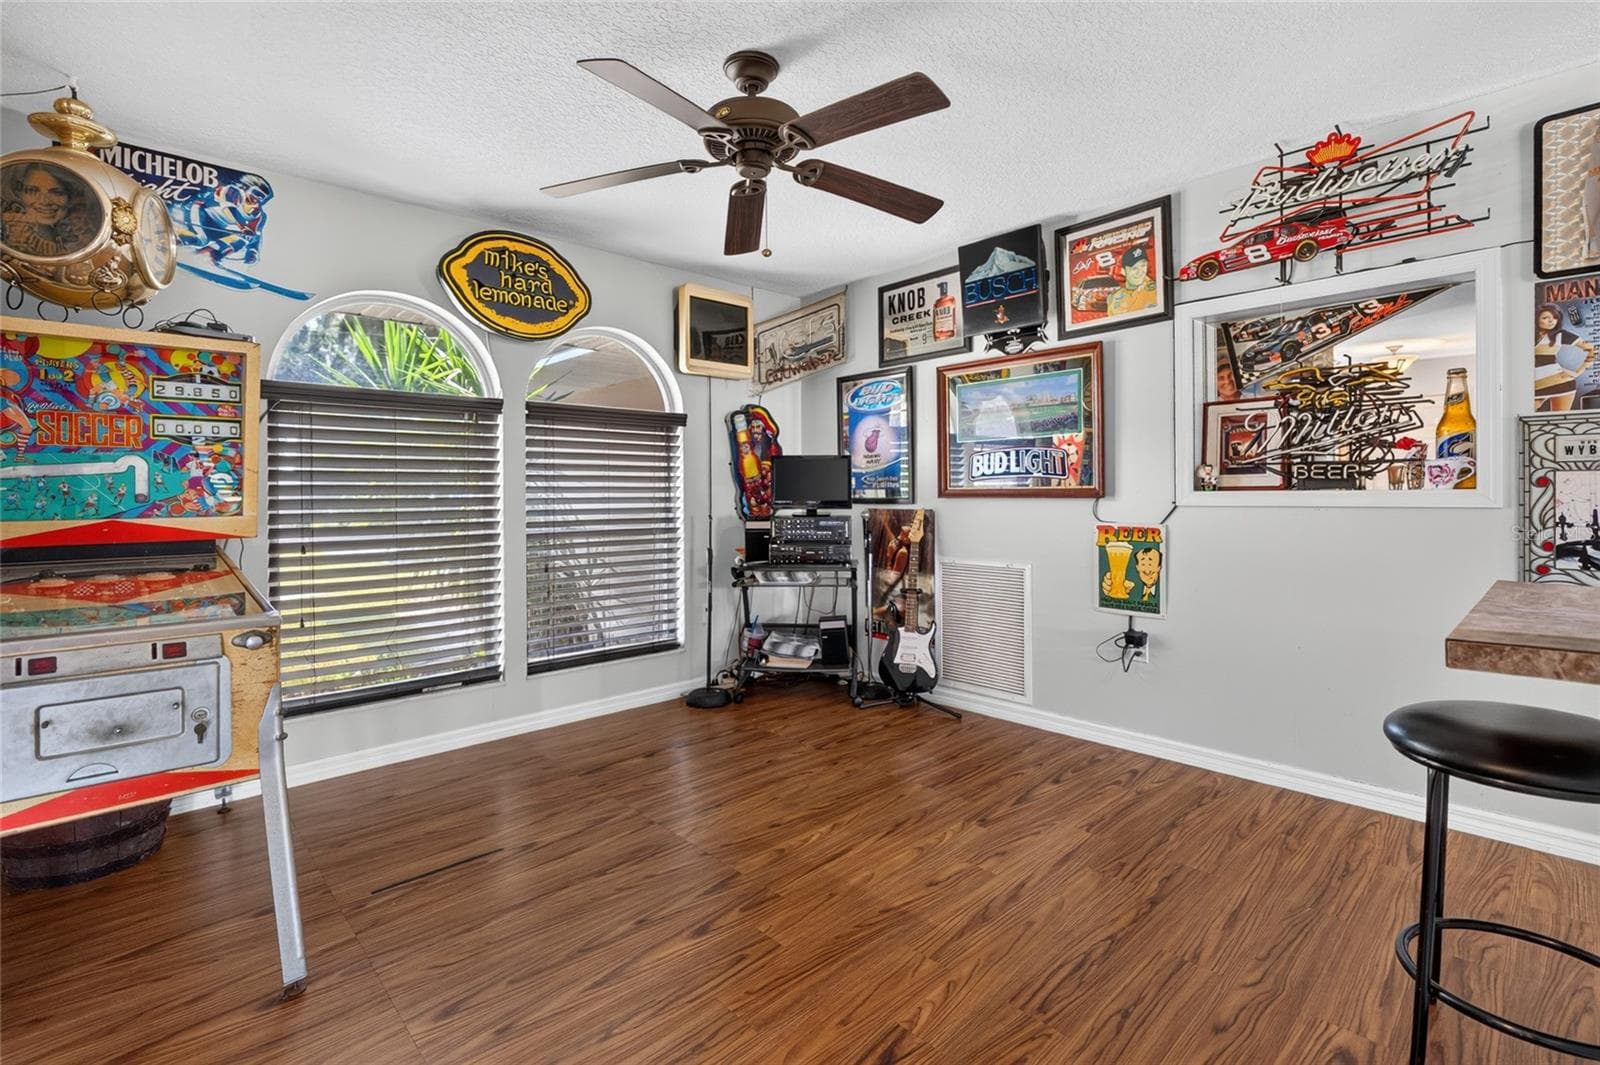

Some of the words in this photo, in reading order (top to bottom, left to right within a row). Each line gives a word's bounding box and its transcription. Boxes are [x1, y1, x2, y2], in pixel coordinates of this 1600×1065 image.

[100, 146, 219, 188] MICHELOB
[484, 250, 549, 280] mike's
[1095, 251, 1116, 268] 8
[1243, 244, 1272, 264] 8
[500, 271, 553, 294] hard
[965, 268, 1038, 305] BUSCH
[1545, 278, 1599, 304] MAN
[472, 280, 568, 313] lemonade
[888, 287, 926, 316] KNOB
[1358, 299, 1381, 314] 3
[892, 309, 932, 325] CREEK
[1311, 322, 1332, 339] 3
[63, 370, 75, 382] 2
[36, 409, 143, 449] SOCCER
[972, 451, 1008, 477] BUD
[1010, 448, 1064, 475] LIGHT
[1295, 464, 1360, 479] BEER
[1096, 525, 1164, 547] BEER
